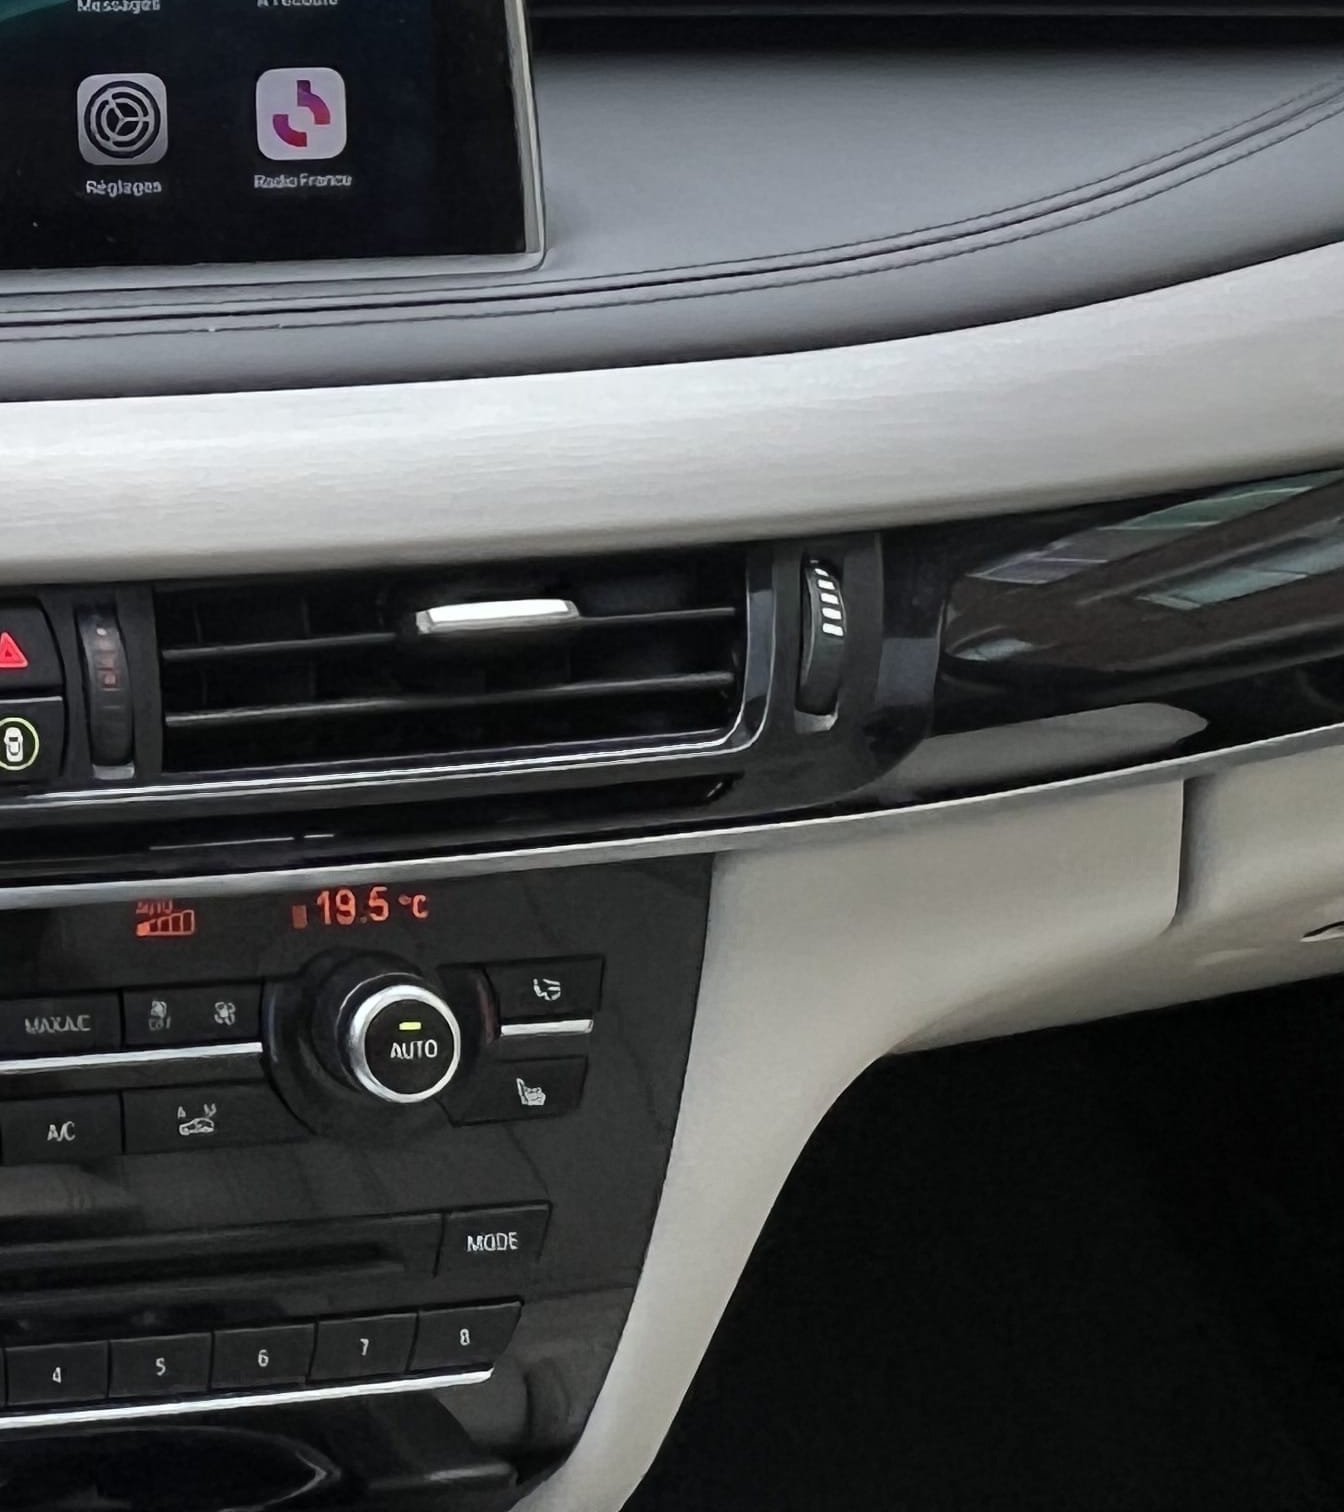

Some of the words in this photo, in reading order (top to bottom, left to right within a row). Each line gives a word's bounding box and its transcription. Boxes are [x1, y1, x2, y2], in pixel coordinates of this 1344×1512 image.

[85, 179, 162, 198] Réglages
[253, 174, 297, 189] Radio
[299, 172, 353, 187] France
[316, 886, 390, 926] 19.5
[390, 1038, 438, 1060] AUTO
[47, 1120, 76, 1142] A/C
[467, 1231, 518, 1252] MODE
[459, 1328, 471, 1346] 8
[359, 1338, 370, 1356] 7
[155, 1357, 166, 1376] 5
[257, 1349, 269, 1367] 6
[52, 1366, 62, 1384] 4
